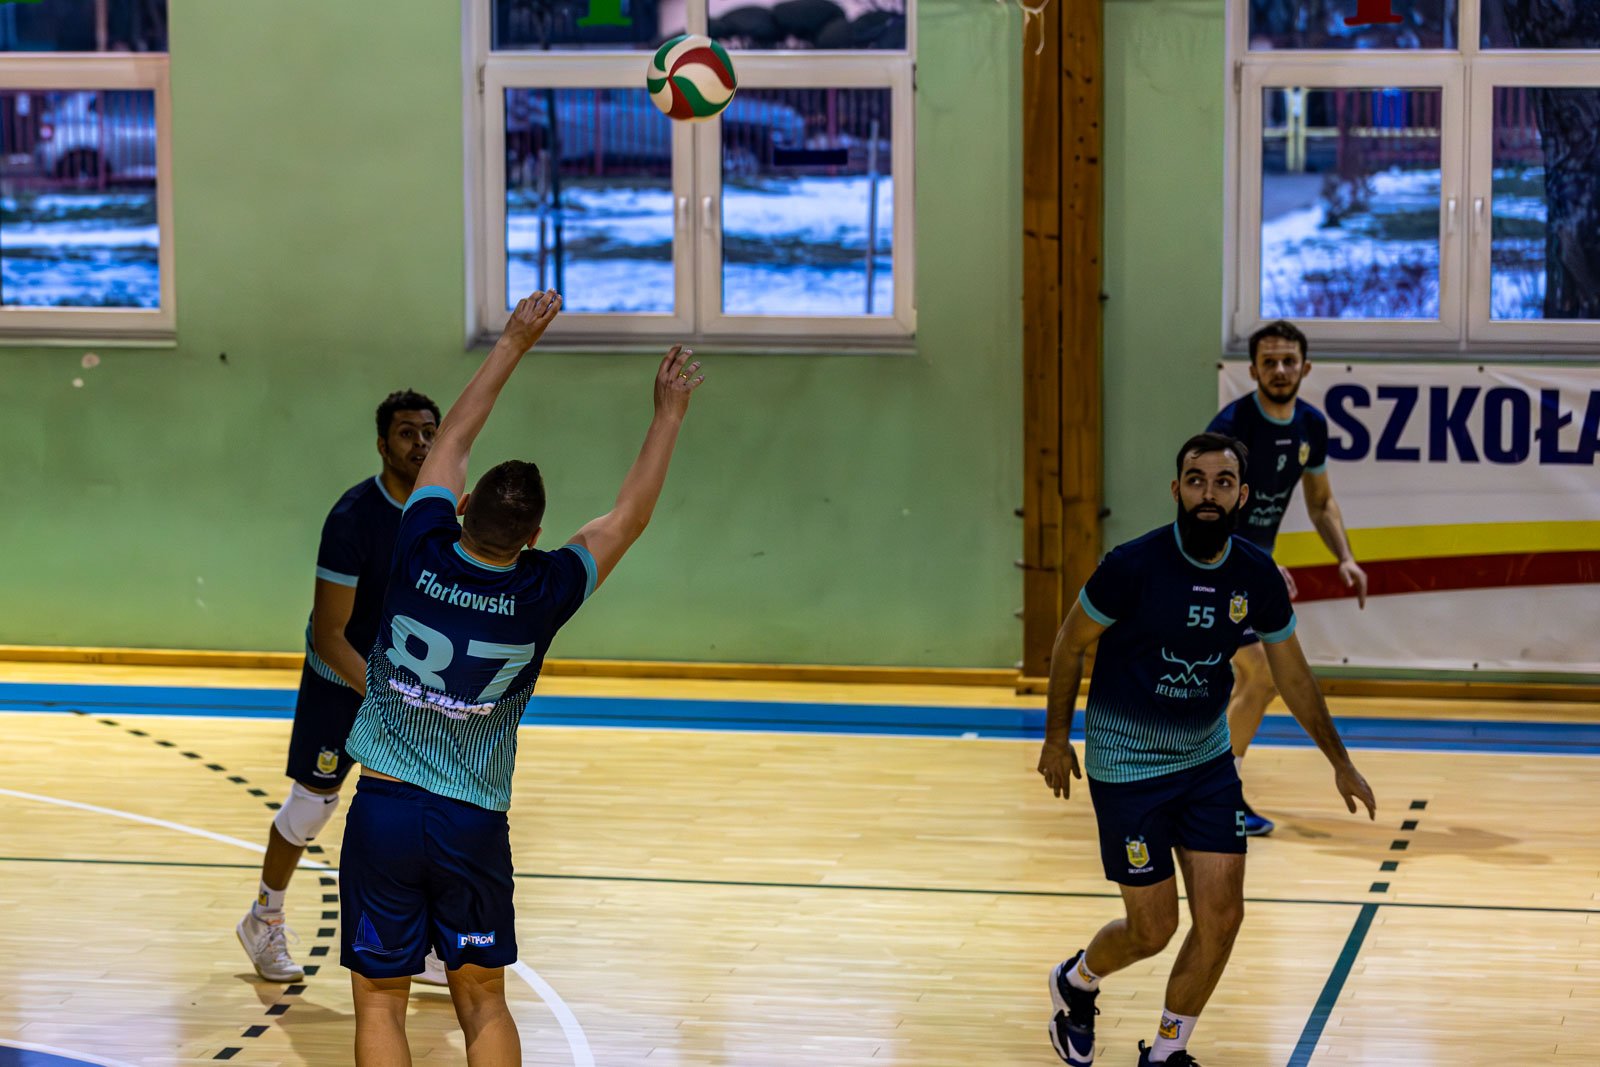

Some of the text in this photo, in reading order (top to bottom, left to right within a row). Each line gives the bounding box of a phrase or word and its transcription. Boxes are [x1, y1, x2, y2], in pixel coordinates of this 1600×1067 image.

[415, 569, 516, 616] Florkowski
[1186, 605, 1216, 629] 55
[386, 614, 536, 703] 87
[1155, 683, 1188, 699] JELENIA
